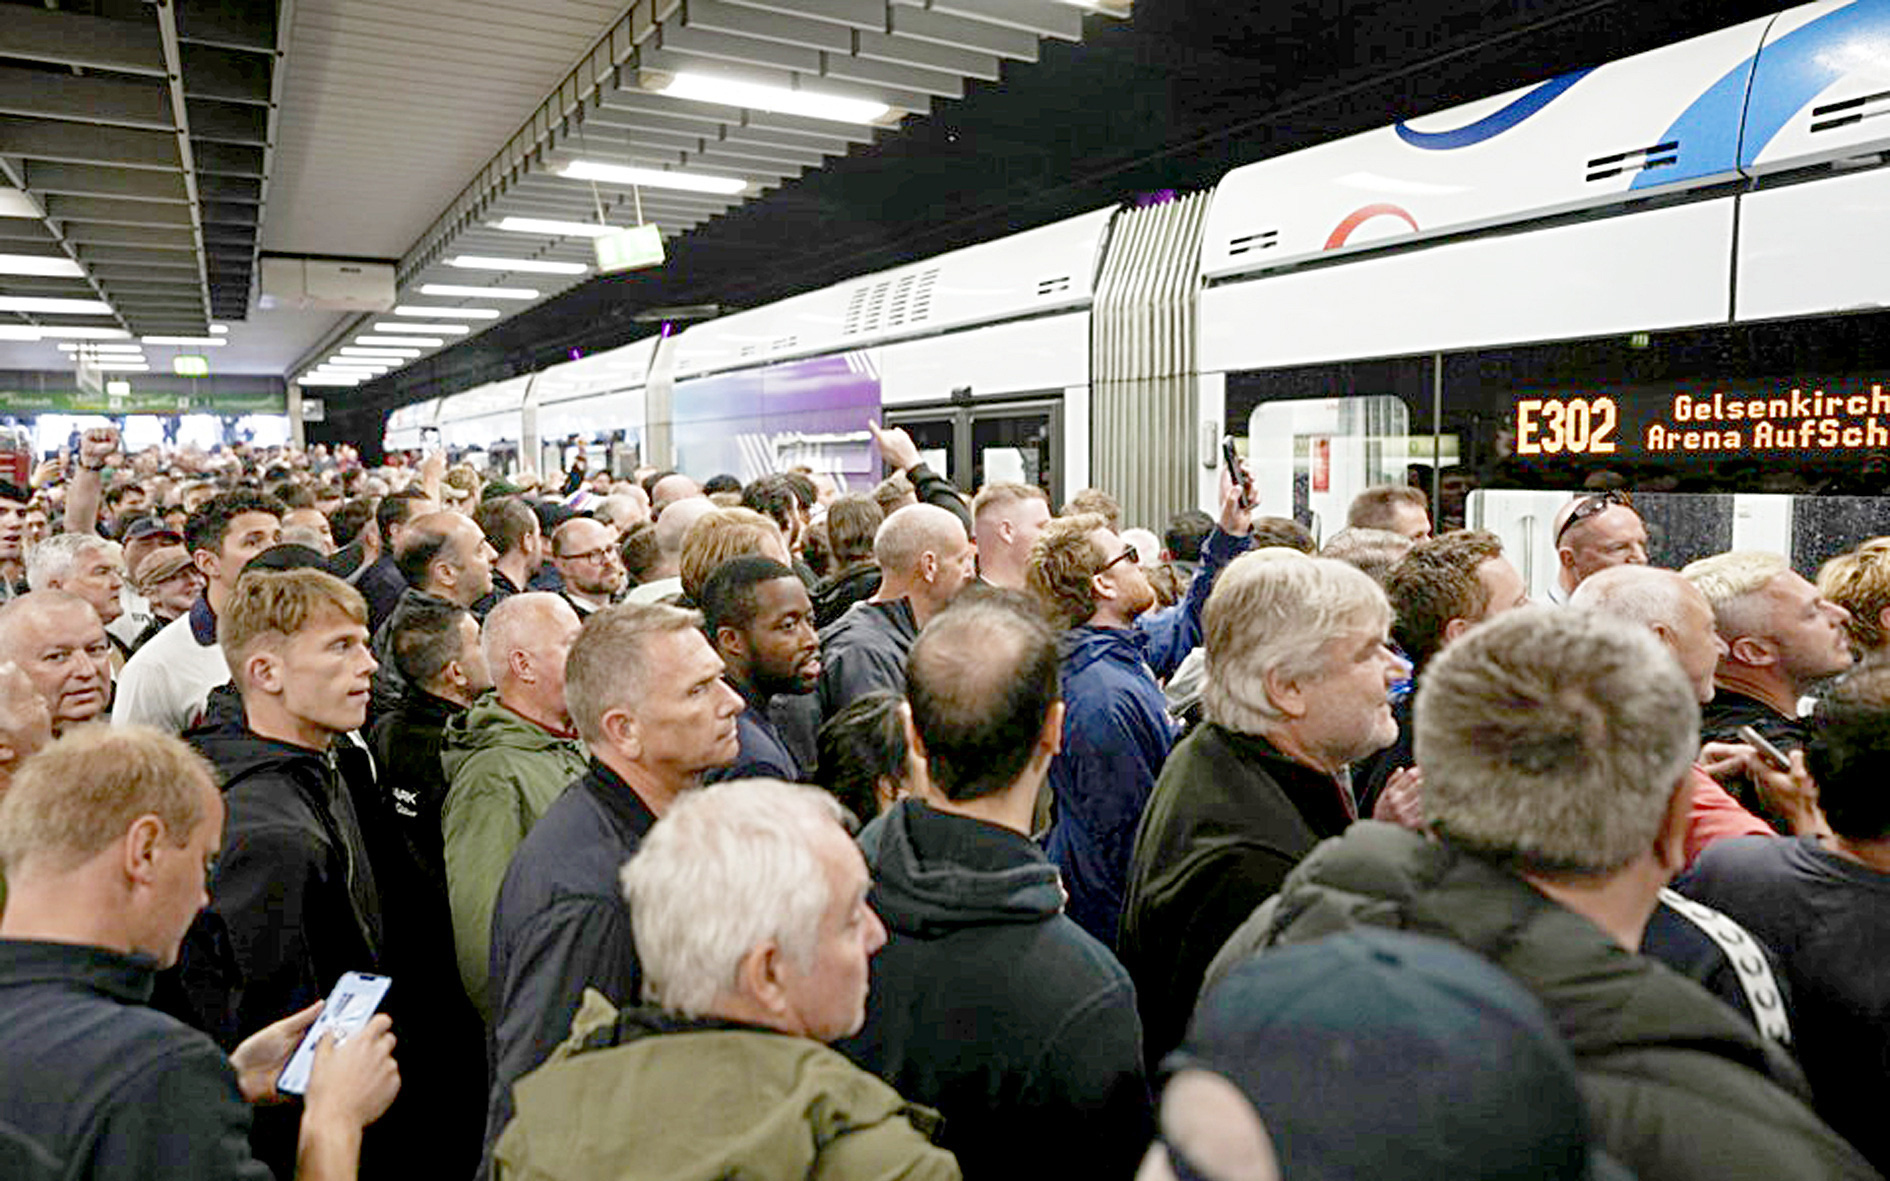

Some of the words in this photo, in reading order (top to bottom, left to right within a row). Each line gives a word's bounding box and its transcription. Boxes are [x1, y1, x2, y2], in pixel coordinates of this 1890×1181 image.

[1674, 384, 1890, 421] Gelsenkirch
[1516, 397, 1617, 454] E302
[1647, 424, 1742, 450] Arena
[1753, 417, 1889, 449] AufSch
